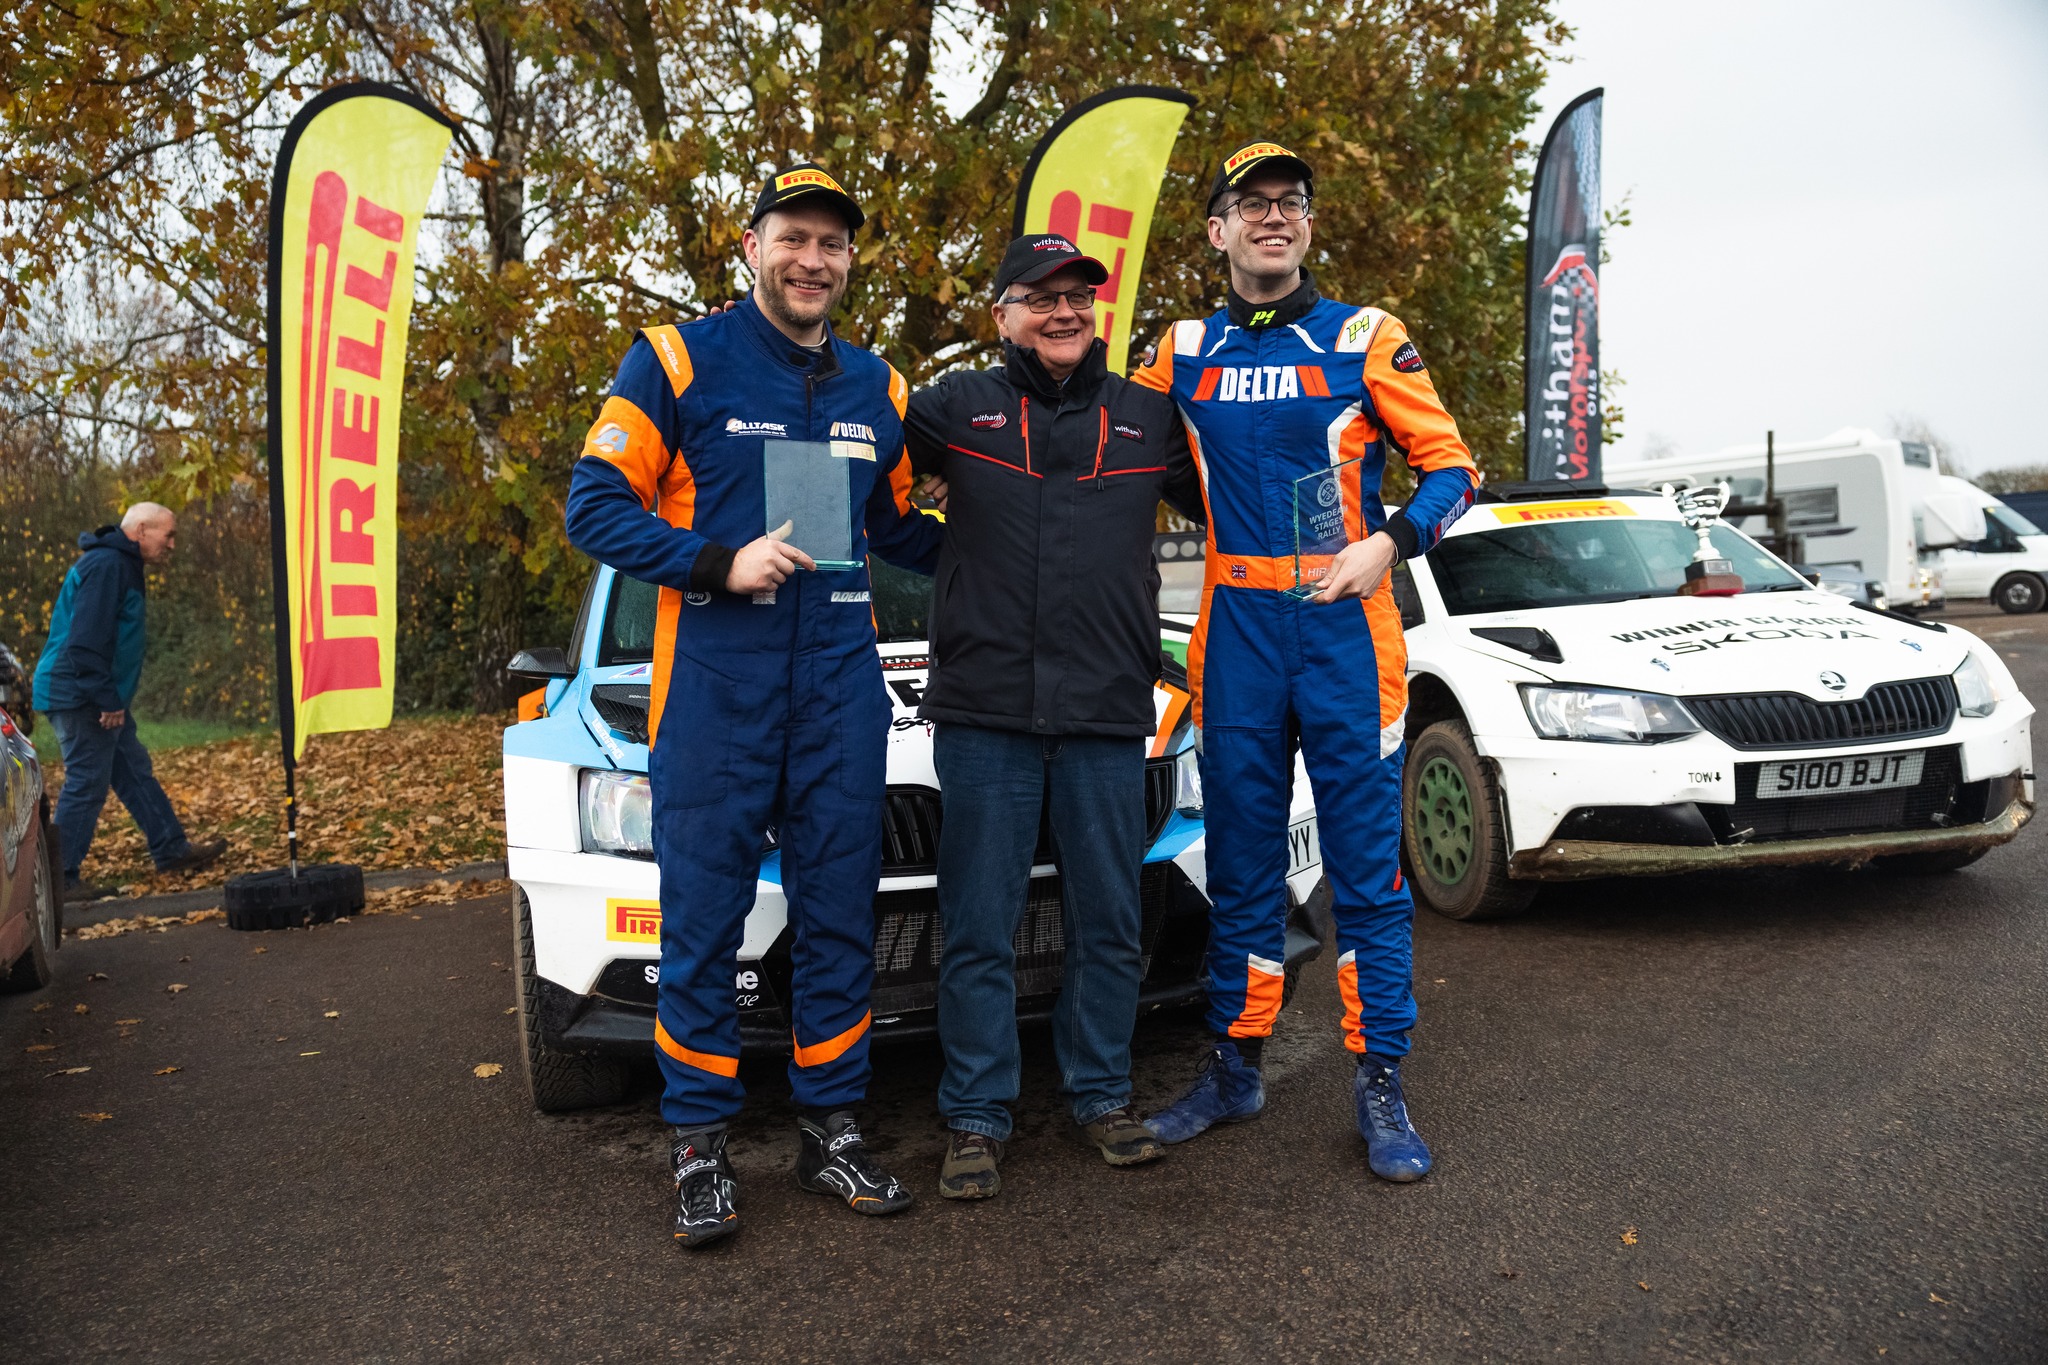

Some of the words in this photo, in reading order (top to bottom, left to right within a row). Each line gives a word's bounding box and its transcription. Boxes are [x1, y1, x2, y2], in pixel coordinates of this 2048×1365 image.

[1395, 349, 1418, 364] witha
[1219, 366, 1298, 402] DELTA
[1587, 368, 1597, 417] OILS
[725, 420, 785, 431] ALLTASK
[841, 422, 867, 440] DELTA
[300, 170, 404, 704] PIRELLI
[1309, 504, 1348, 525] WYEDEAN
[1518, 506, 1618, 521] PIRELLI
[1314, 515, 1344, 532] STAGES
[1317, 526, 1341, 540] RALLY
[831, 591, 870, 602] D.DEAR
[1610, 618, 1738, 643] WINNER
[1688, 772, 1713, 783] TOW
[1777, 761, 1844, 791] S100
[1850, 755, 1907, 786] BJT
[1289, 825, 1310, 867] YY
